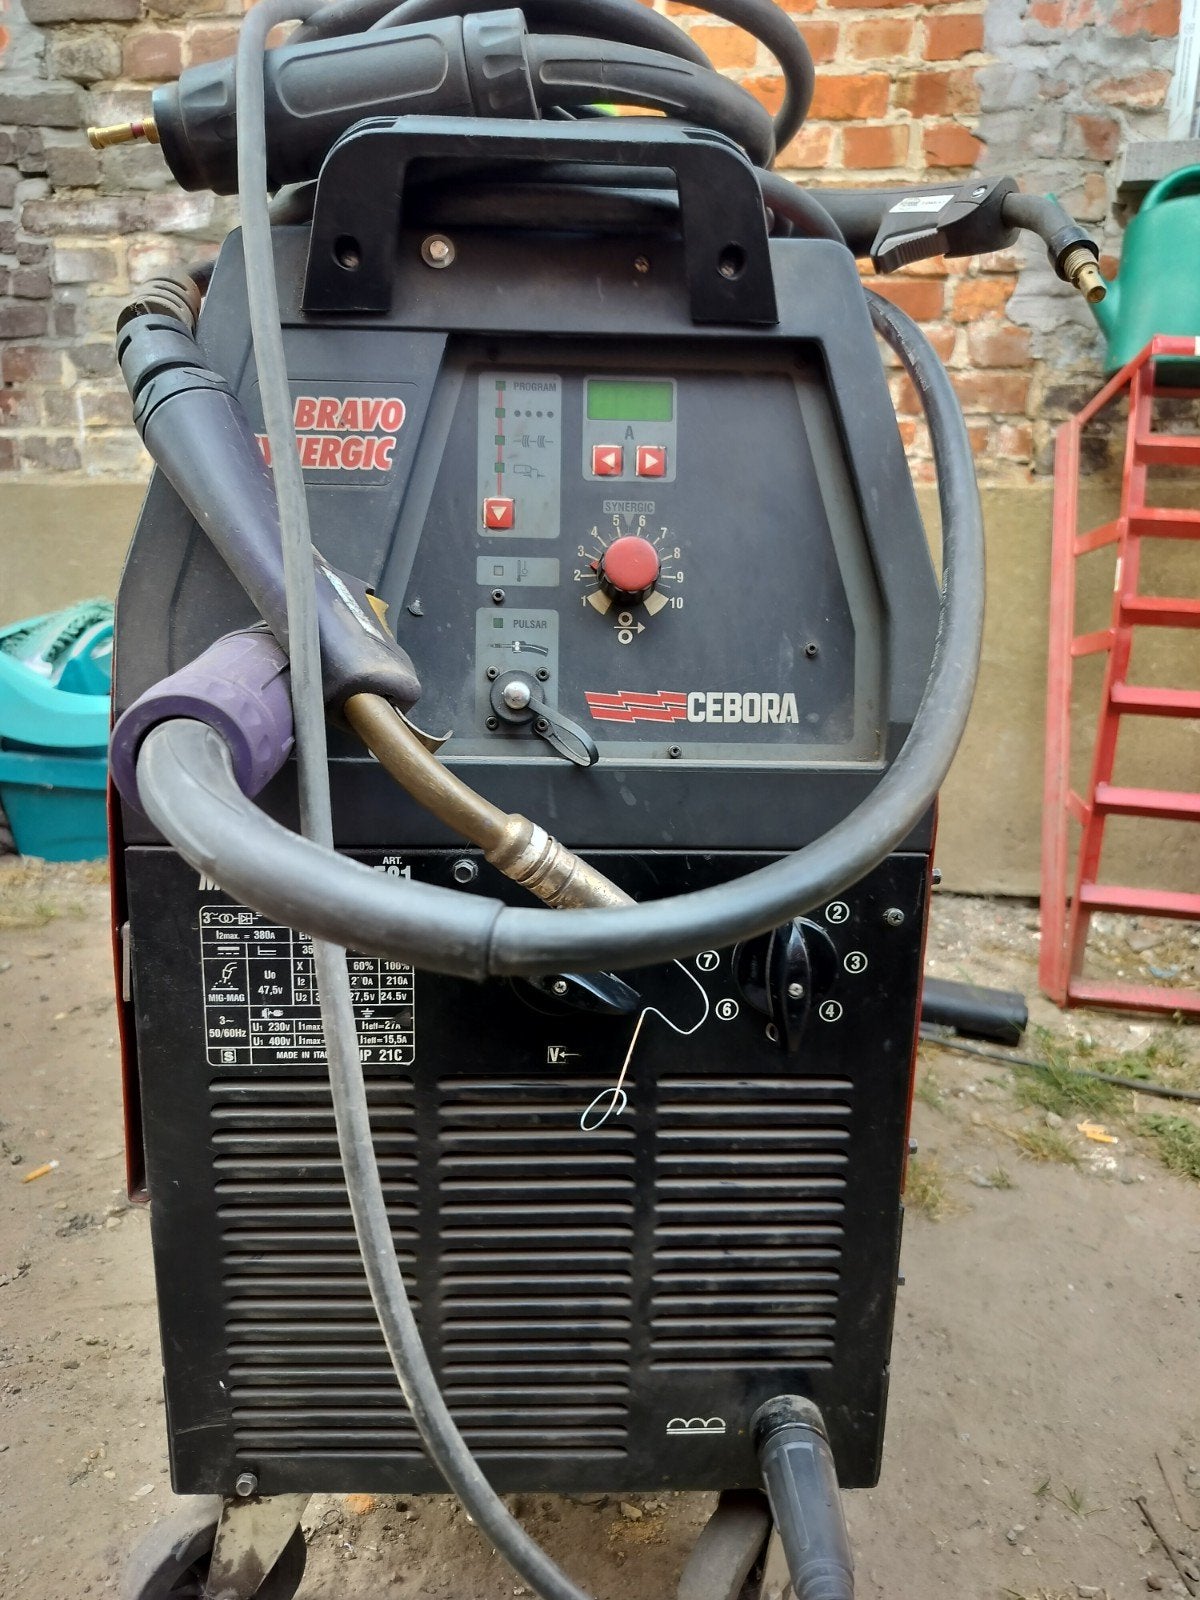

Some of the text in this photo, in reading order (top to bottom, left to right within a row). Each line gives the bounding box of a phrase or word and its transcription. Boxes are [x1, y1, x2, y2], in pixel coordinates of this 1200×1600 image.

[513, 382, 557, 392] PROGRAM
[294, 397, 406, 433] BRAVO
[624, 425, 635, 441] A
[605, 502, 655, 513] SYNERGIC
[612, 515, 620, 526] 5
[638, 515, 646, 527] 6
[590, 526, 598, 538] 4
[660, 527, 668, 539] 7
[577, 545, 585, 557] 3
[673, 547, 681, 559] 8
[573, 569, 581, 581] 2
[676, 571, 684, 583] 9
[581, 597, 587, 607] 1
[670, 597, 684, 609] 10
[513, 620, 547, 629] PULSAR
[687, 692, 799, 723] CEBORA
[382, 856, 403, 865] ART.
[832, 906, 842, 920] 2
[253, 930, 276, 940] 380A
[296, 961, 410, 971] X 60% 100%
[703, 954, 713, 967] 7
[850, 955, 860, 969] 3
[386, 976, 409, 986] 210A
[208, 994, 246, 1003] MIG-MAG
[295, 992, 308, 1002] U2
[722, 1003, 732, 1017] 6
[825, 1003, 835, 1017] 4
[252, 1022, 264, 1032] U1
[209, 1028, 248, 1039] 50/60Hz
[253, 1036, 264, 1046] U1
[223, 1051, 234, 1062] S
[276, 1051, 298, 1059] MADE
[301, 1051, 310, 1059] IN
[360, 1048, 403, 1062] IP 21C
